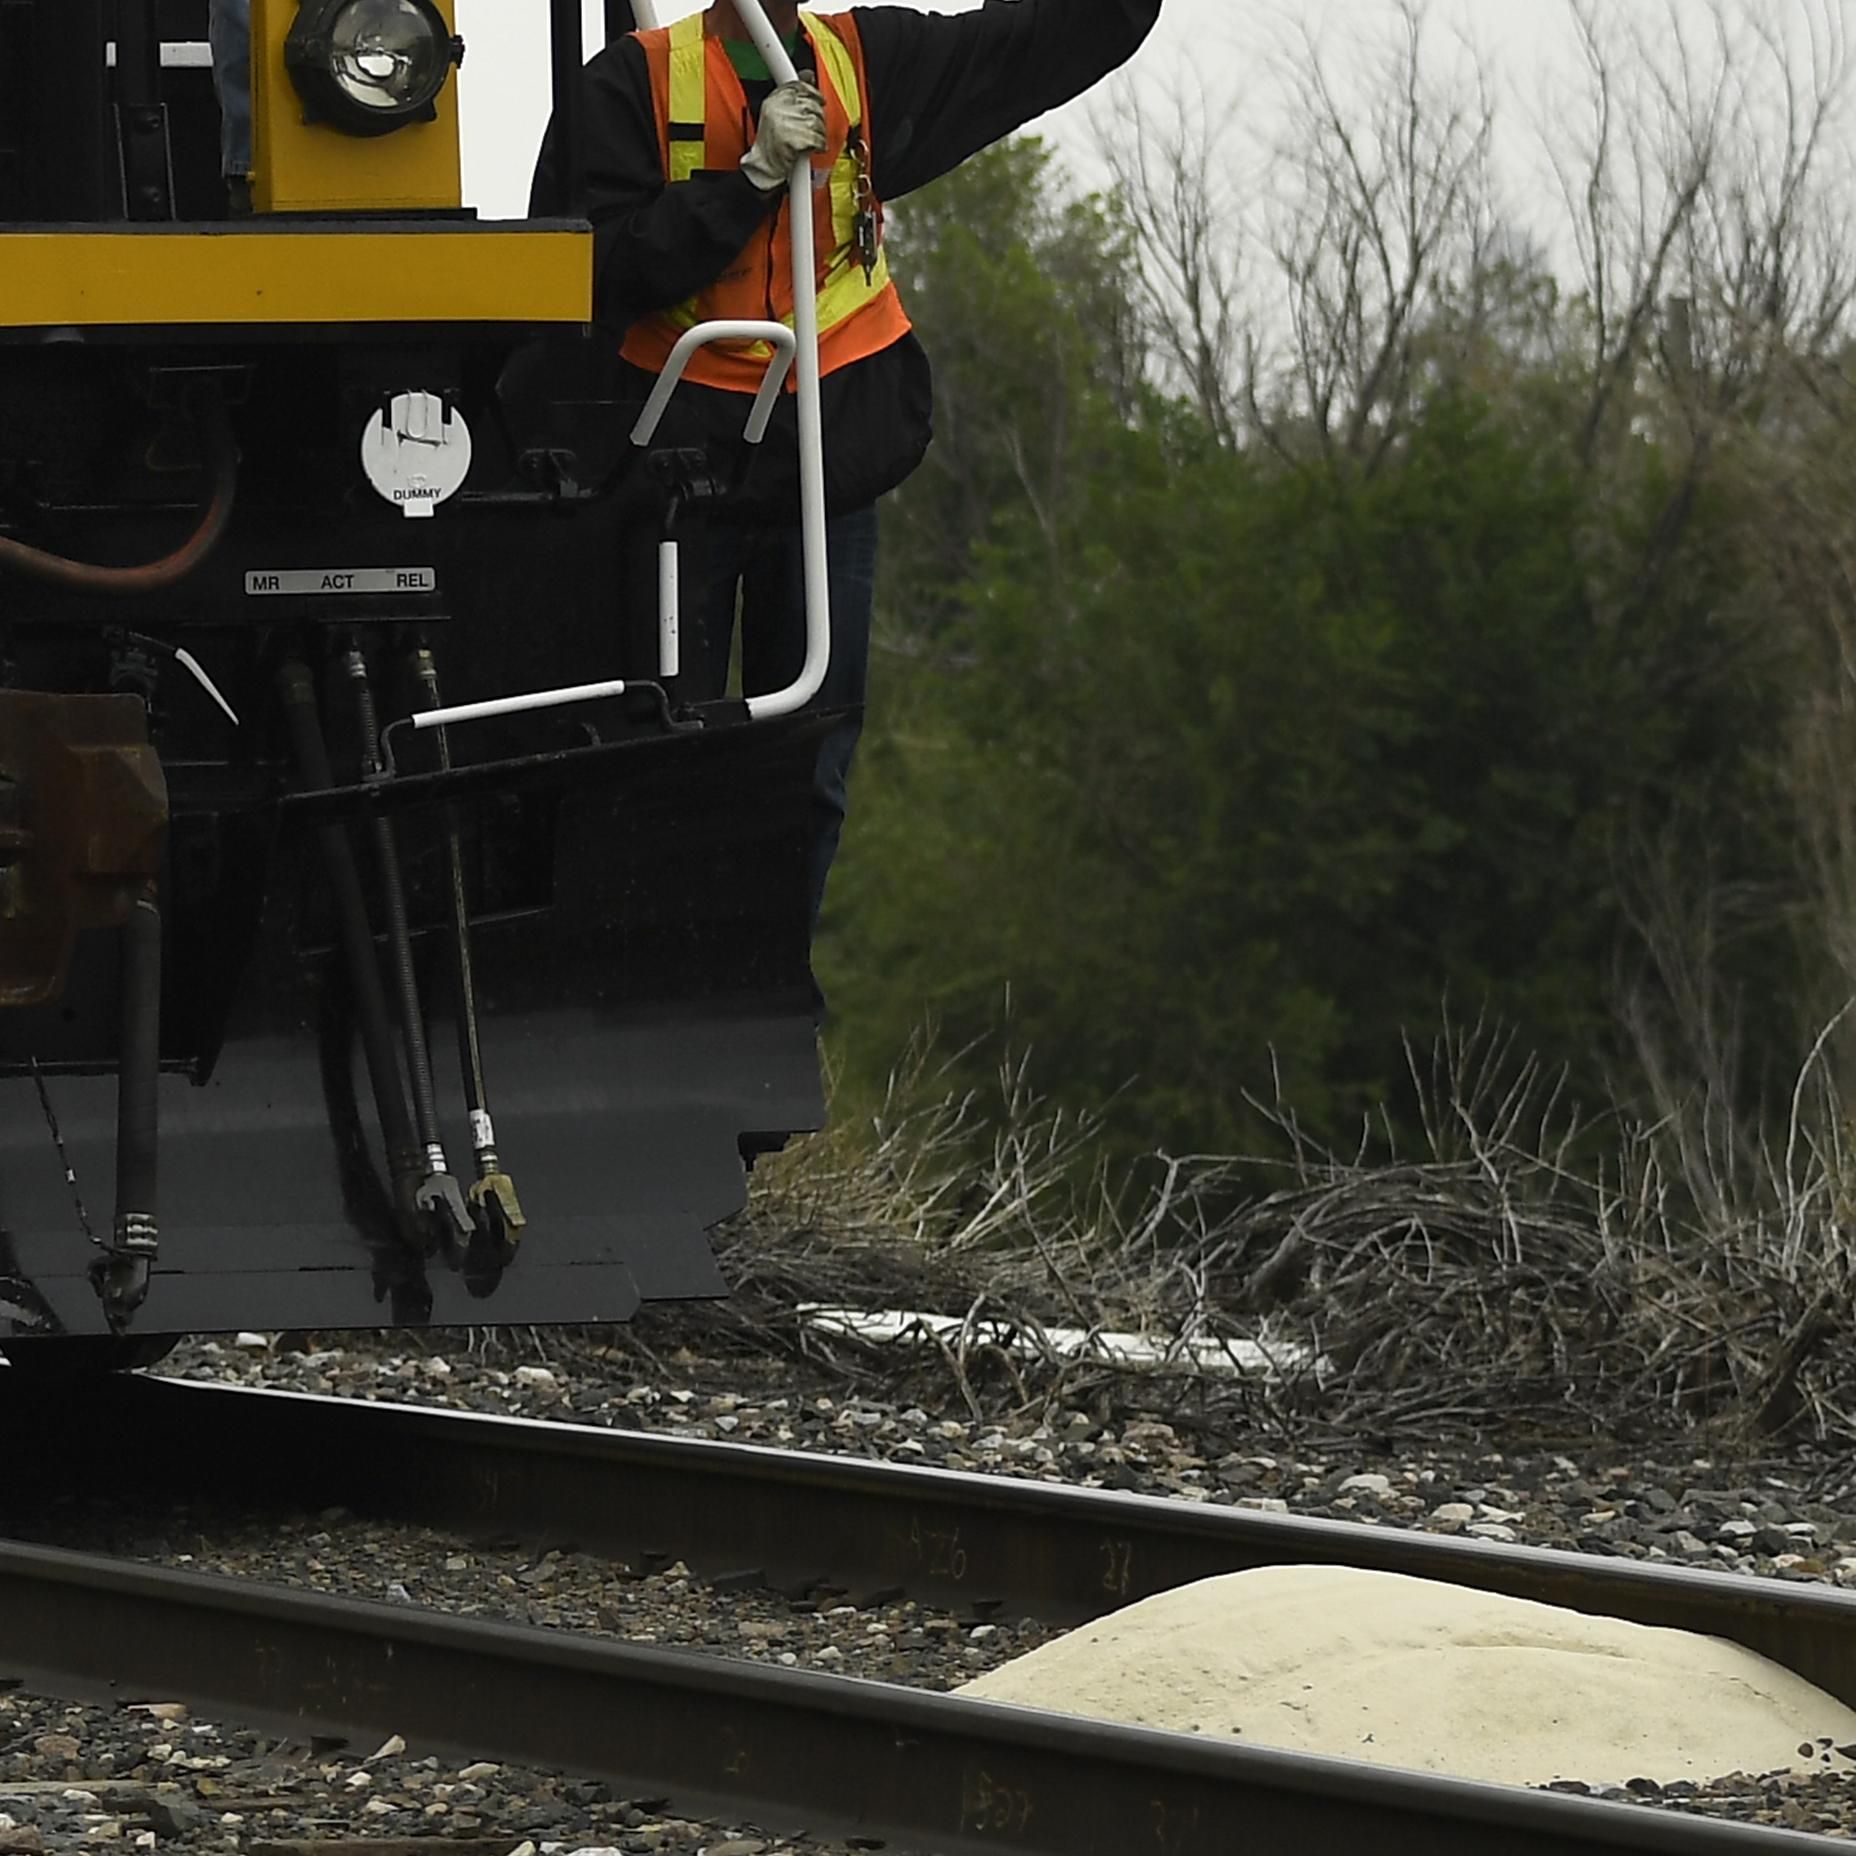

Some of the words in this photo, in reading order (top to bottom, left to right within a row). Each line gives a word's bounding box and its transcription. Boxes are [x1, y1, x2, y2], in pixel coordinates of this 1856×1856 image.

[393, 487, 442, 501] DUMMY
[252, 575, 280, 591] MR
[320, 574, 355, 590] ACT
[396, 573, 429, 588] REL
